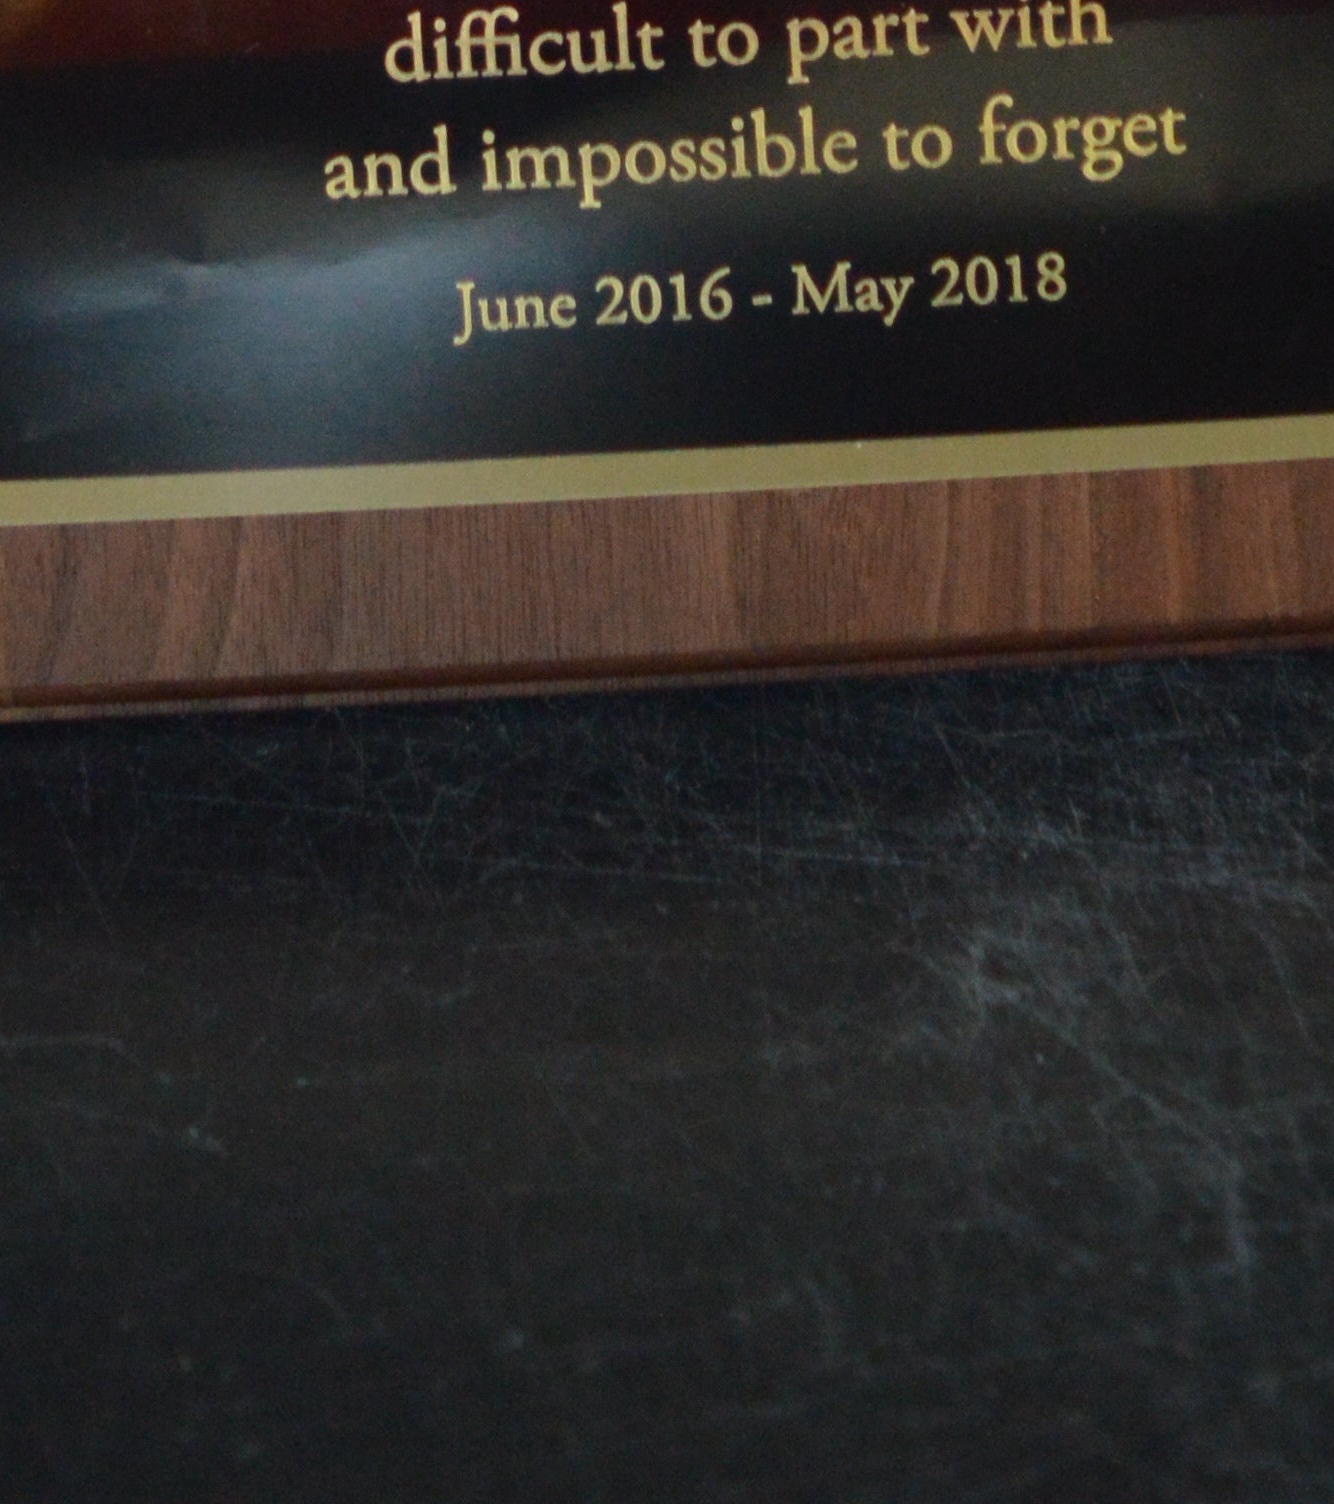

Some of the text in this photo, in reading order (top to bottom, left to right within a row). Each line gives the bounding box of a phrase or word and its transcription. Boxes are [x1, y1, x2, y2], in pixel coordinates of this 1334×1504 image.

[384, 0, 665, 84] difficult
[687, 18, 760, 68] to
[785, 7, 931, 86] part
[324, 93, 1187, 210] and impossible to forget
[453, 281, 577, 346] June
[595, 266, 733, 326] 2016
[790, 260, 915, 327] May
[930, 251, 1068, 308] 2018
